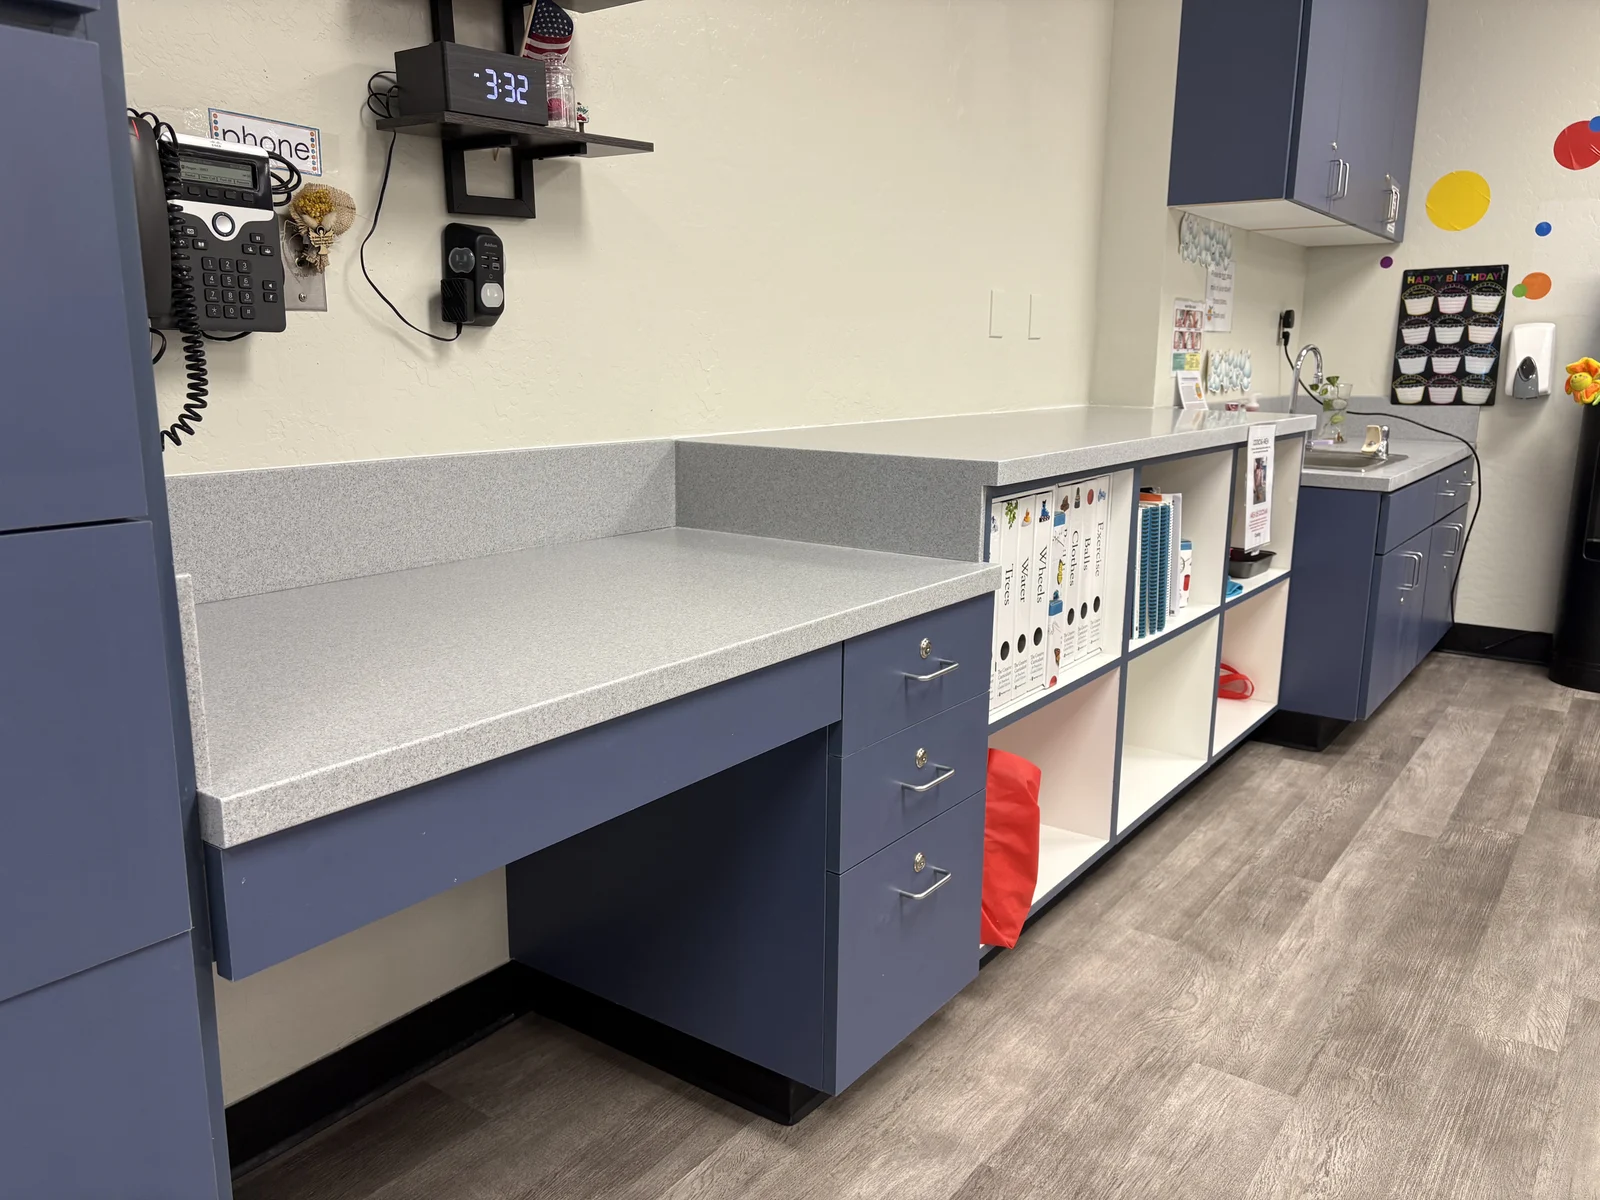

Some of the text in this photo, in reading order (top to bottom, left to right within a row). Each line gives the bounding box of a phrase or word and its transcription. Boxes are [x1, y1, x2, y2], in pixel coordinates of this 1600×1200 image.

[485, 68, 529, 105] 3:32
[1407, 275, 1443, 284] HAPPY
[1069, 530, 1079, 586] Clothes
[1083, 537, 1091, 571] Balls
[1095, 522, 1104, 577] Exercise
[1003, 563, 1014, 606] Trees
[1020, 557, 1029, 603] Water
[1036, 545, 1048, 604] Wheels
